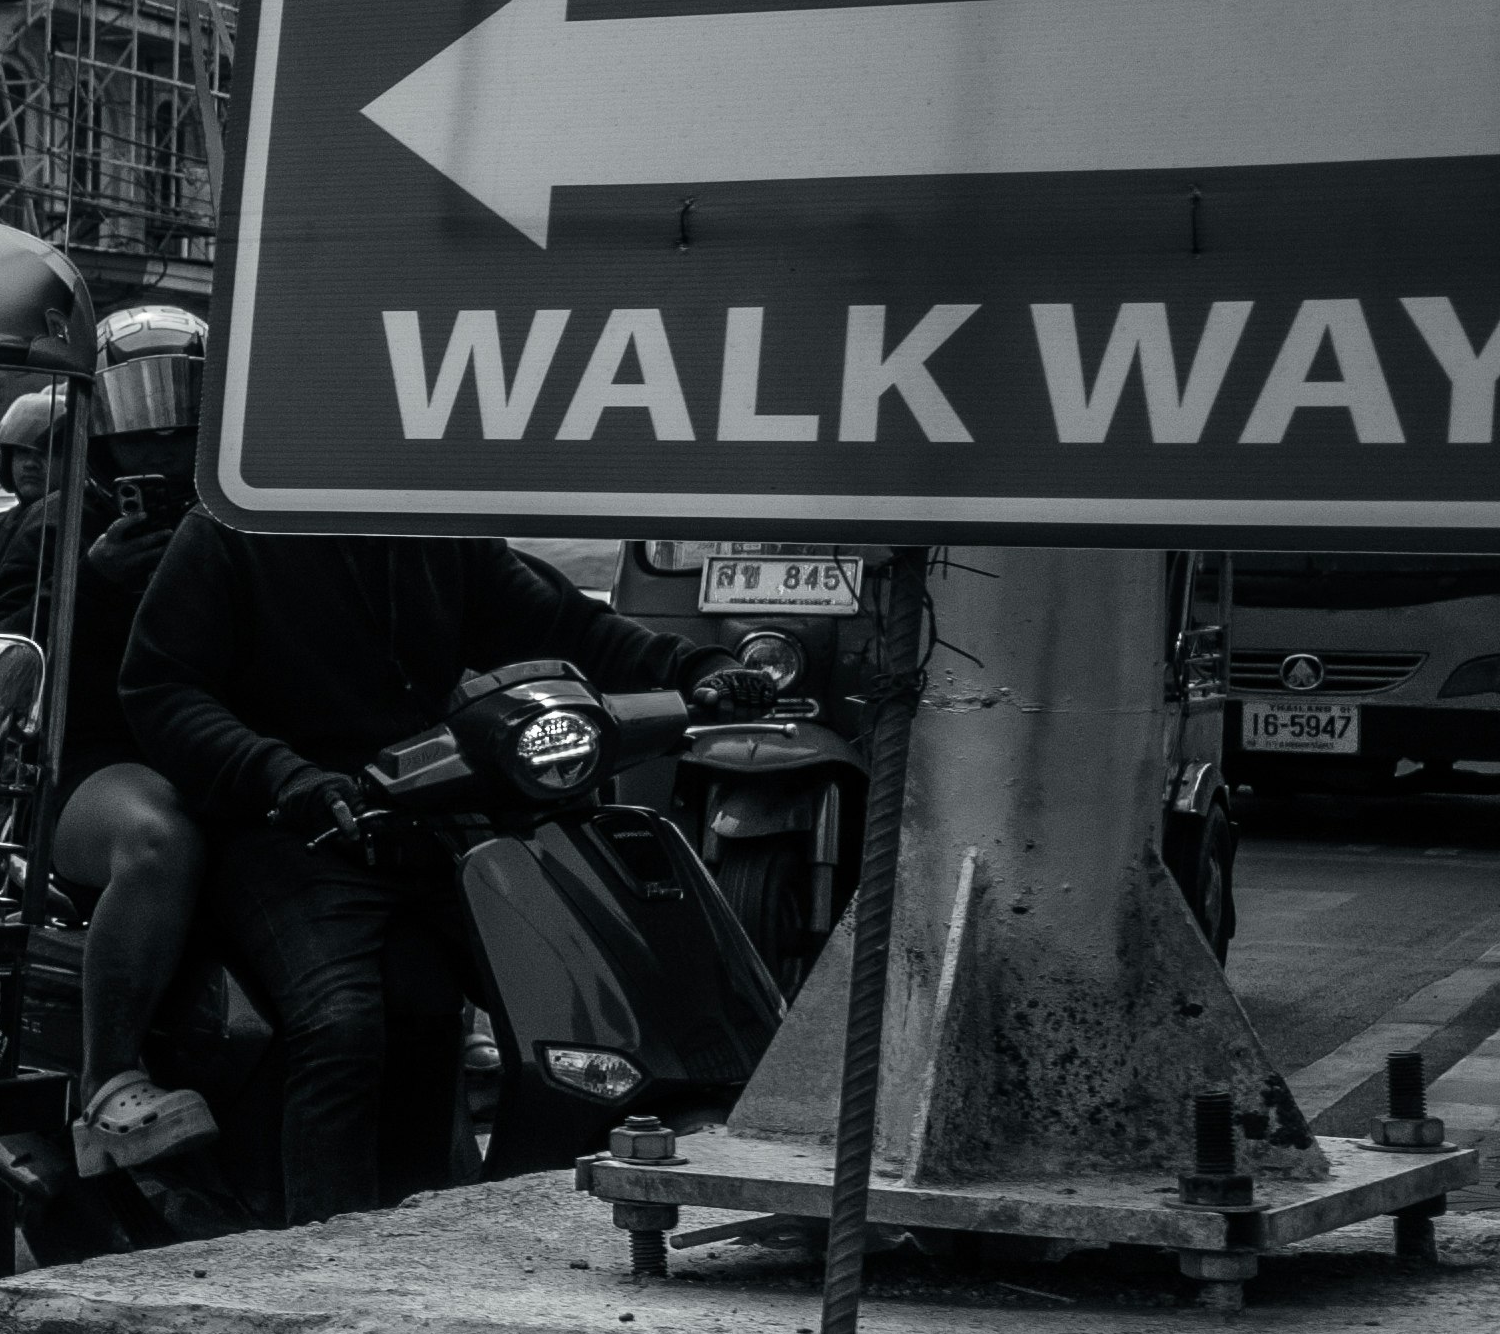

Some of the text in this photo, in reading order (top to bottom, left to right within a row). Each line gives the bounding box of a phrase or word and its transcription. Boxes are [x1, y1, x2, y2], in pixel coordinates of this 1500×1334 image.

[381, 295, 1500, 446] WALK WAY
[783, 564, 840, 591] 845
[1252, 713, 1352, 740] 16-5947
